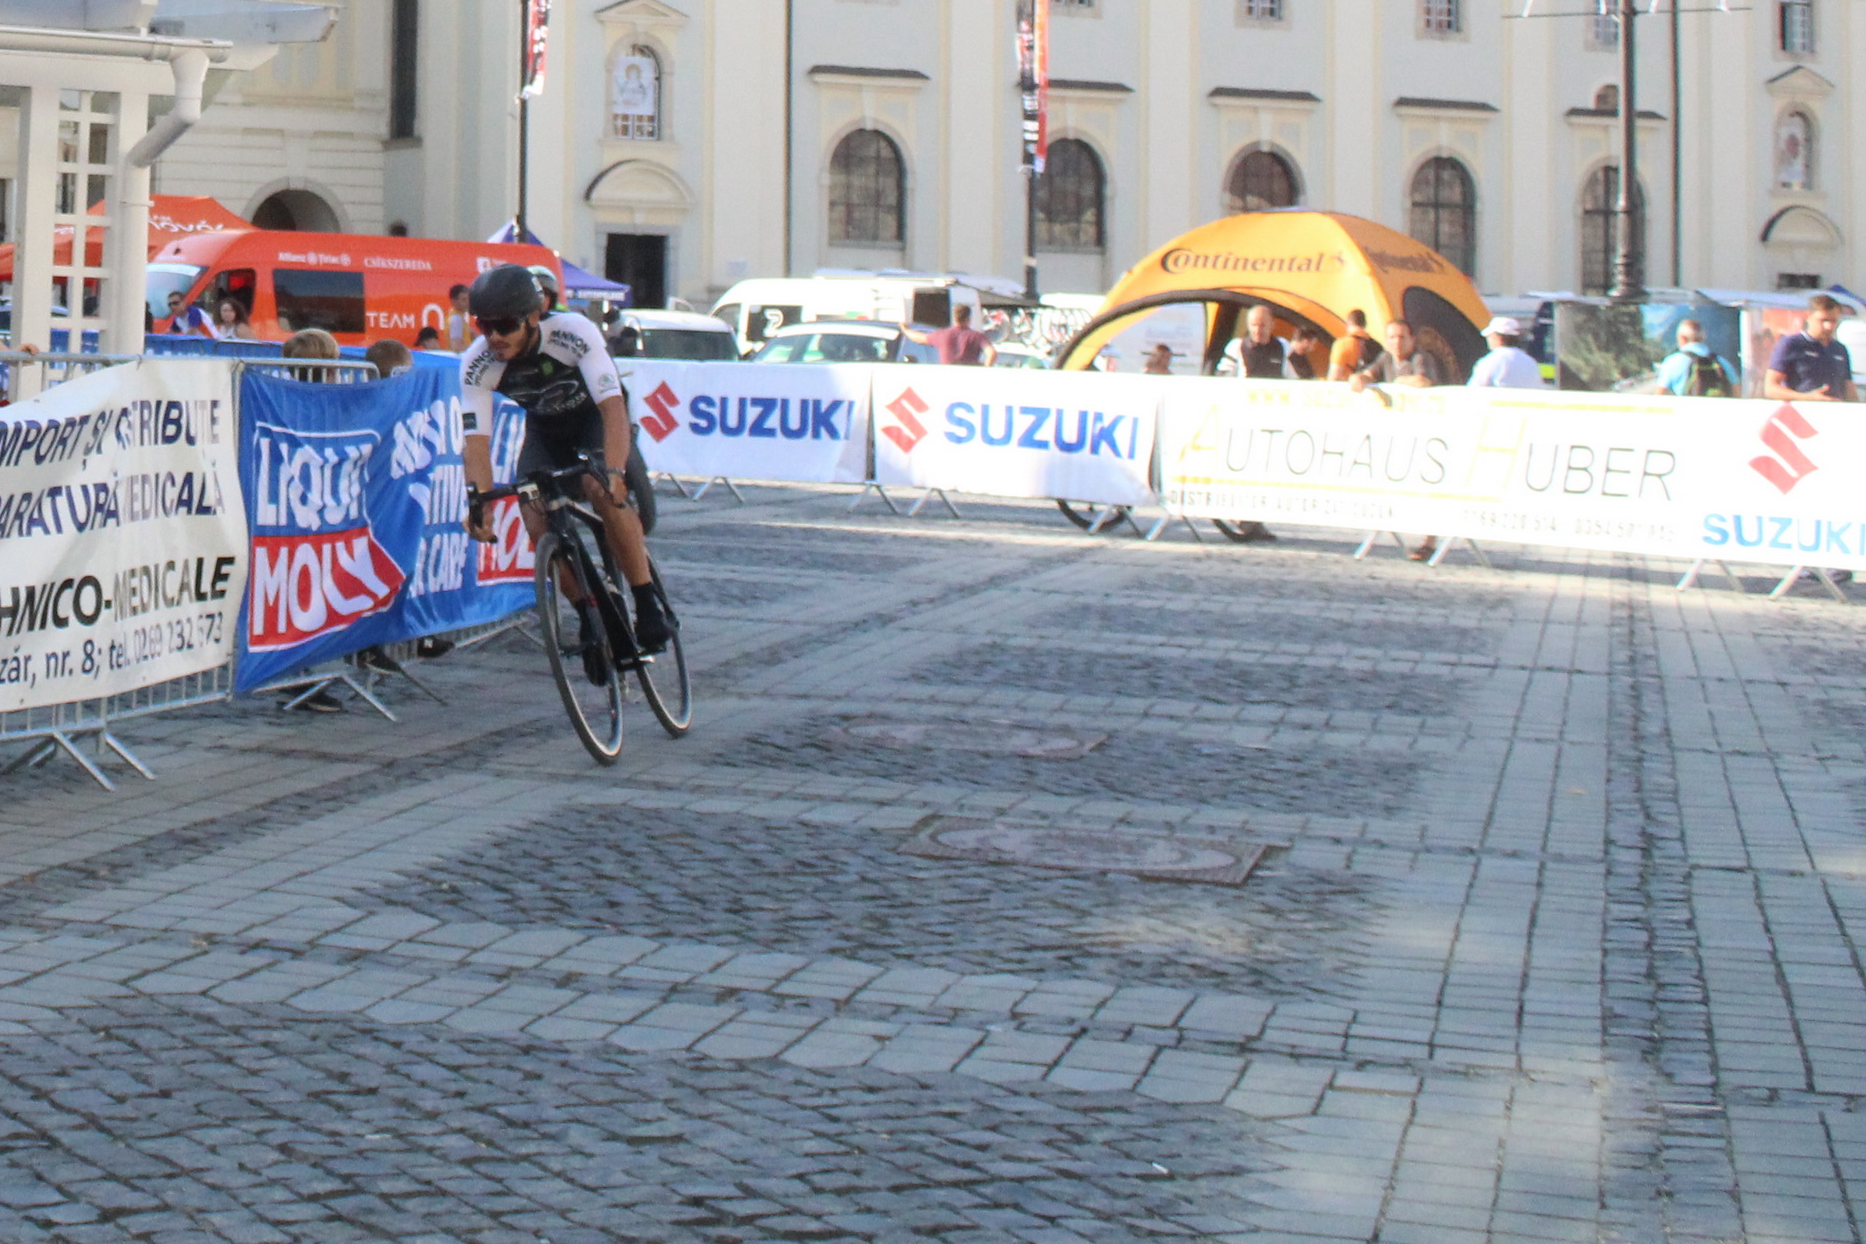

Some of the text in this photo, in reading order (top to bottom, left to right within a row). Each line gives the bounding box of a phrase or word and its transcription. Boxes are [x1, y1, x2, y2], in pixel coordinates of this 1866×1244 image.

[1161, 248, 1324, 274] Continental
[365, 311, 415, 329] TEAM
[464, 350, 492, 387] PANNO
[689, 393, 855, 442] SUZUKI
[944, 400, 1140, 460] SUZUKI
[1176, 404, 1677, 502] AUTOHAUS HUBER
[1702, 512, 1866, 558] SUZUKI
[252, 535, 391, 637] MOLY
[44, 650, 74, 678] nr.
